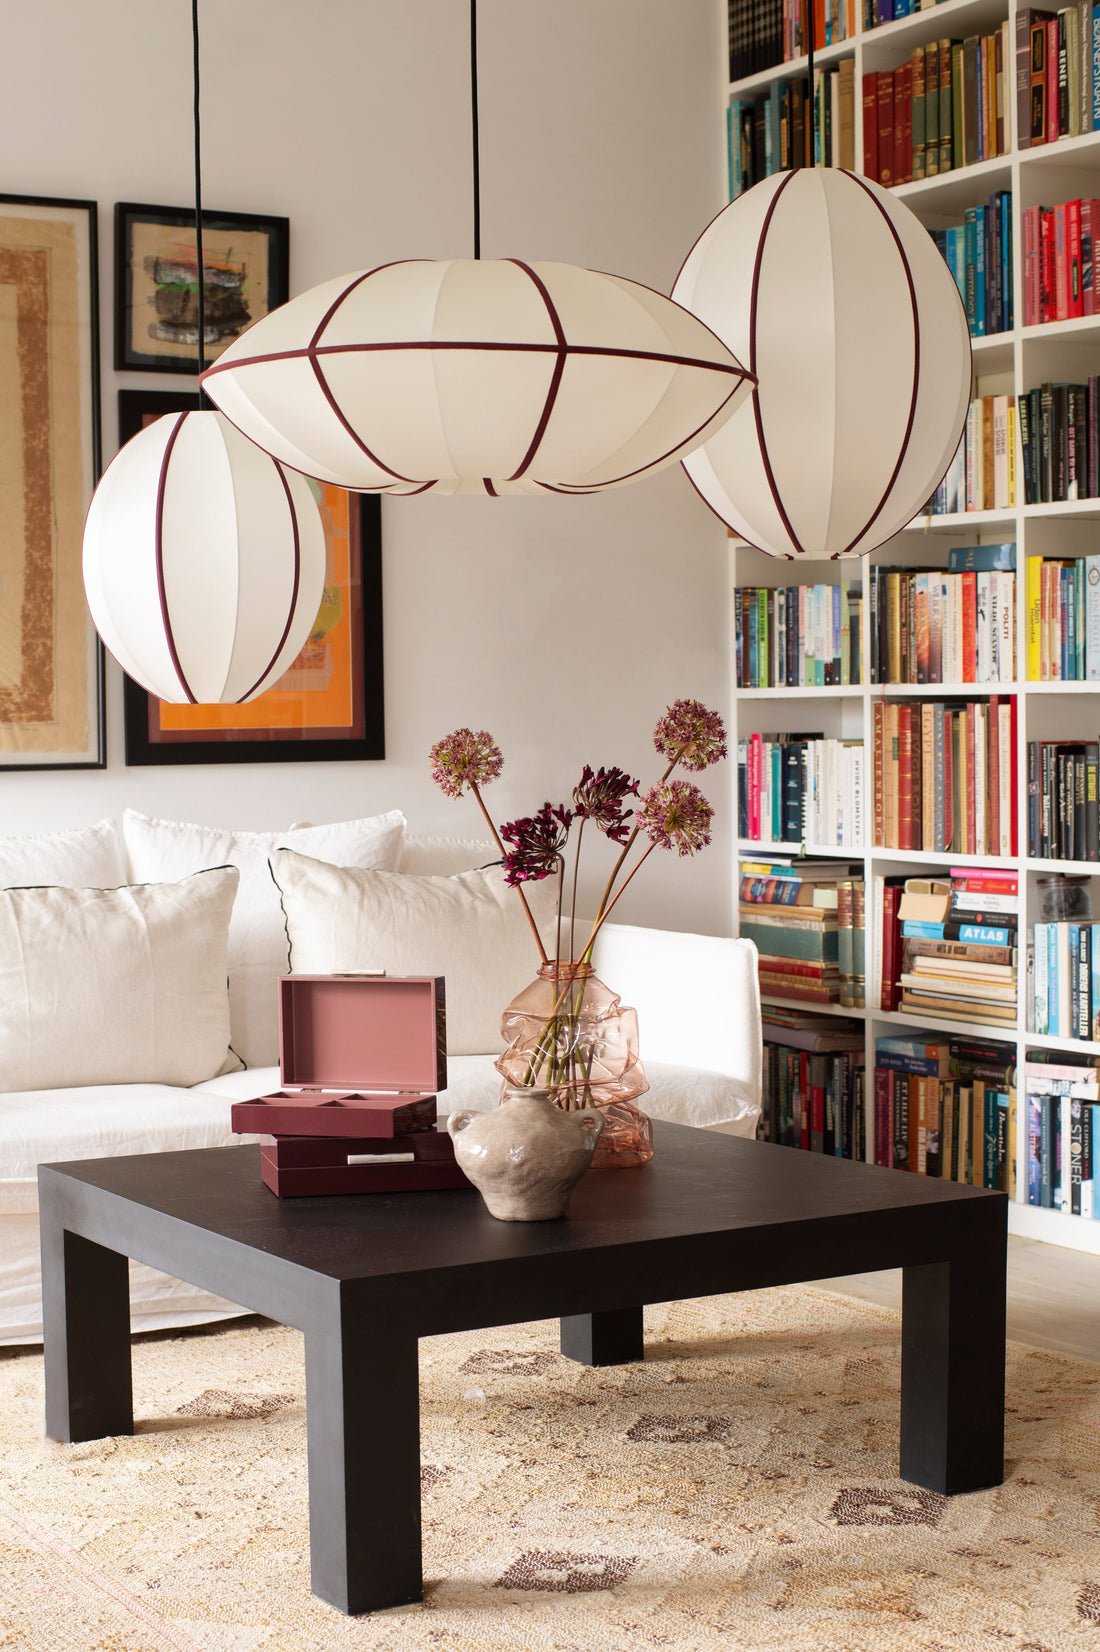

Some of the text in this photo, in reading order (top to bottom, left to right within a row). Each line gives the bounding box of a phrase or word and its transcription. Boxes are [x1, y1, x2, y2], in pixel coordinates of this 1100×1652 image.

[1059, 49, 1067, 88] RENÉE
[967, 265, 975, 316] HISTOLOGY
[923, 711, 932, 755] EGYPT
[963, 927, 1004, 942] ATLAS
[1079, 993, 1088, 1036] KARTELLER
[901, 1081, 908, 1095] ET
[918, 1126, 926, 1172] FRA ASKEN
[1071, 1124, 1082, 1185] STONER
